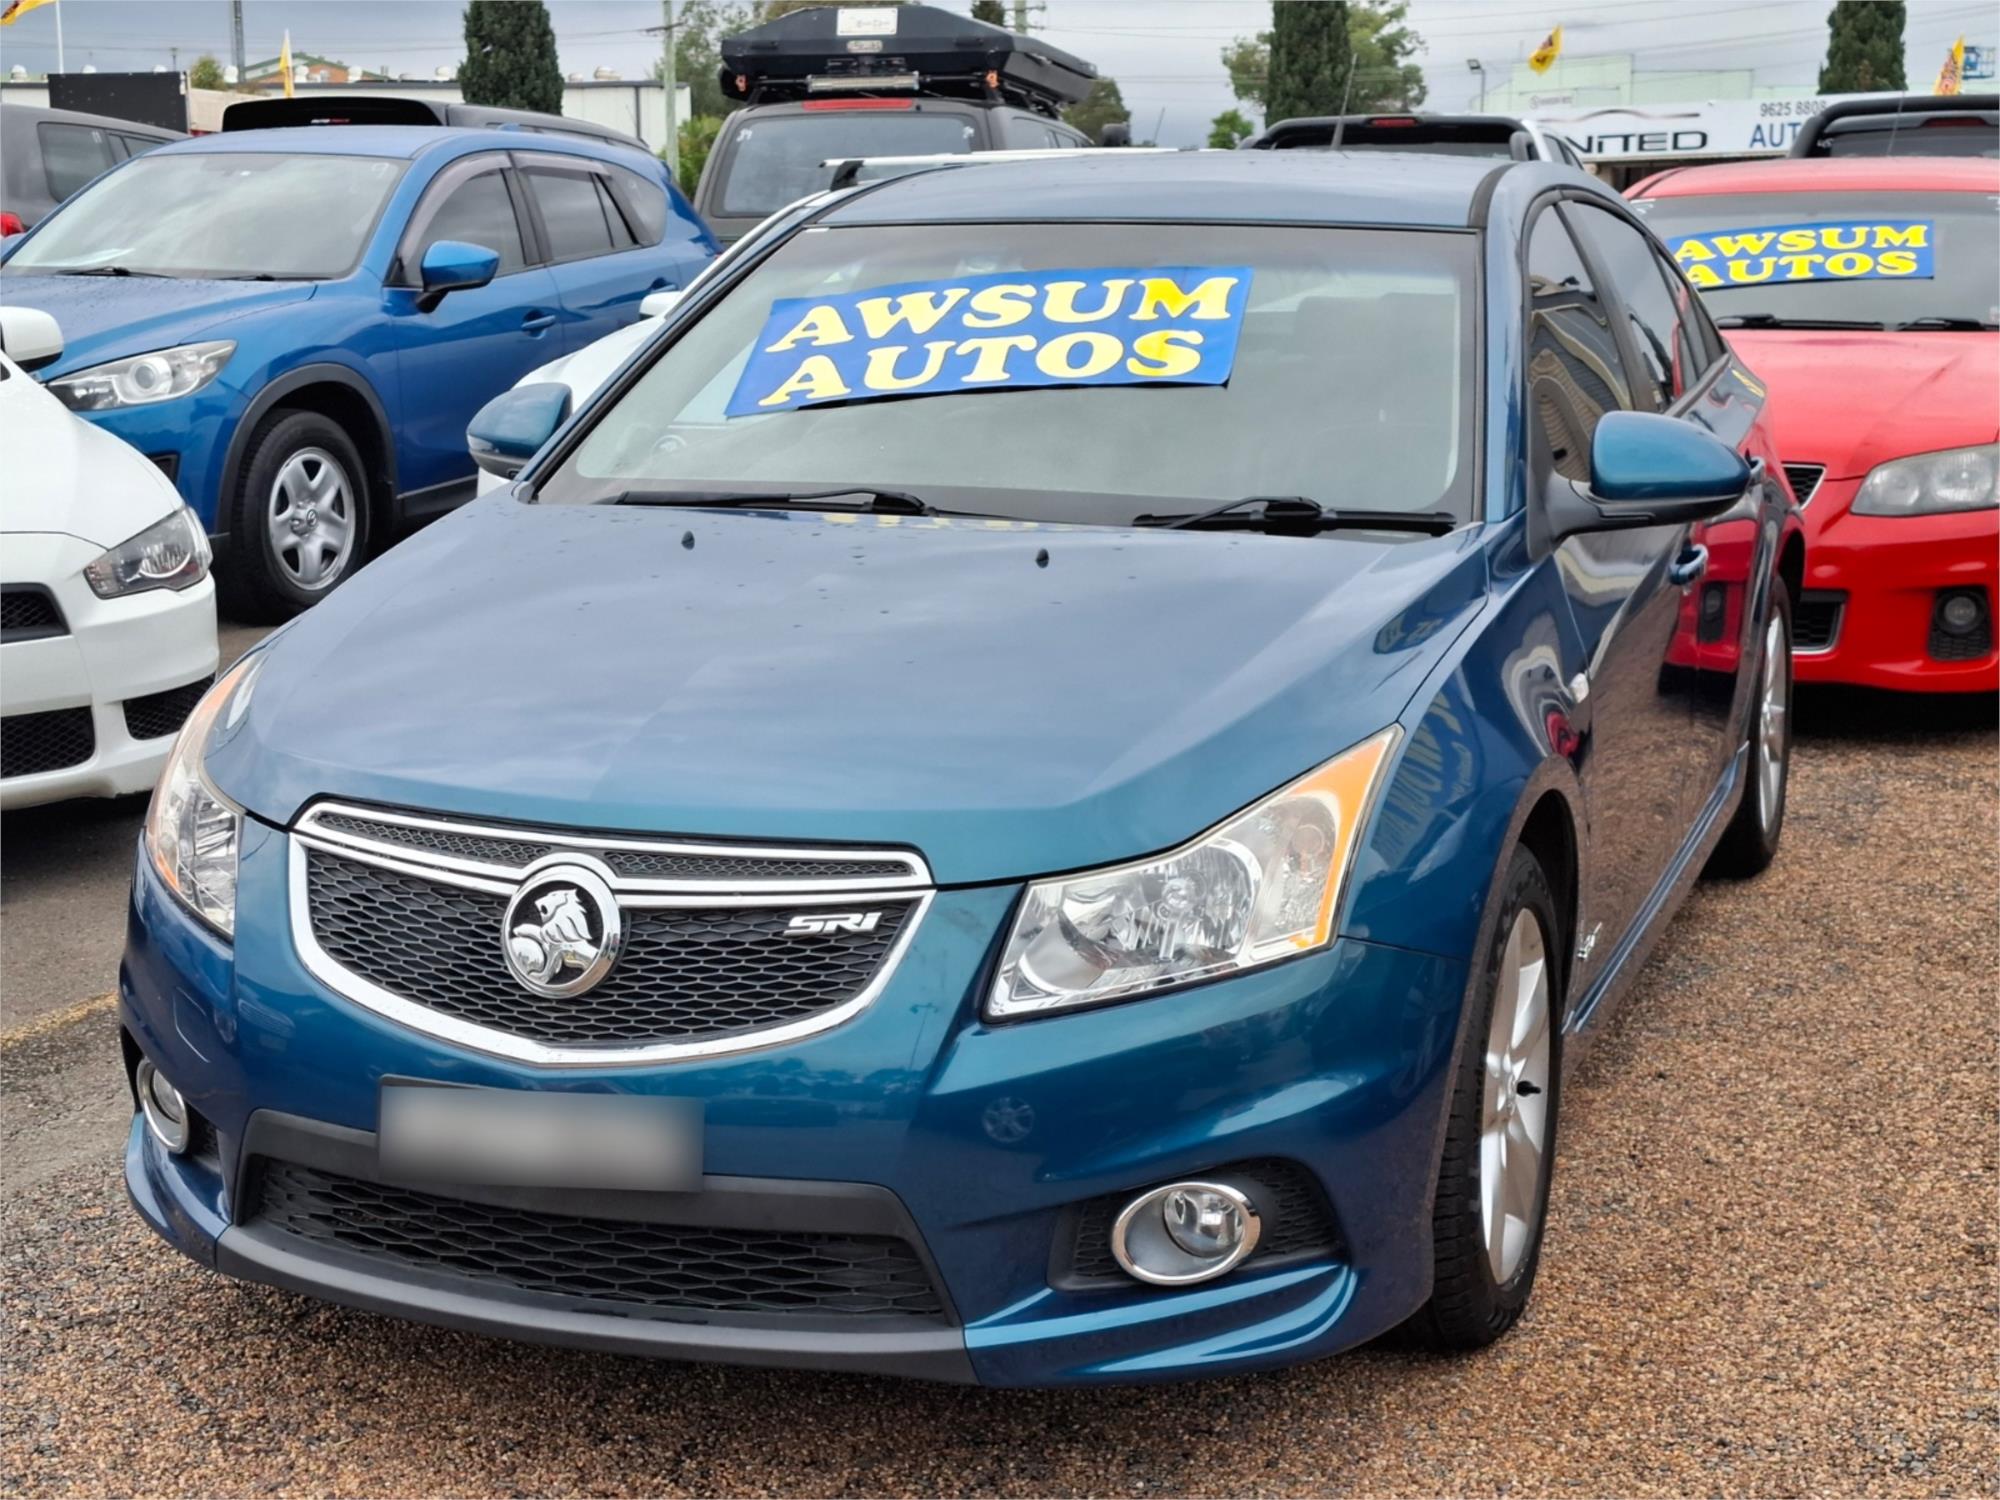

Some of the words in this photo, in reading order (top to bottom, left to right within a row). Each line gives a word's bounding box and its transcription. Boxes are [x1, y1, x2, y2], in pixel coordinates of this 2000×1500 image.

[1760, 102, 1791, 117] 9625
[1674, 225, 1929, 263] AWSUM
[1685, 251, 1918, 287] AUTOS
[764, 277, 1239, 353] AWSUM
[757, 330, 1204, 406] AUTOS
[783, 912, 882, 937] SRI
